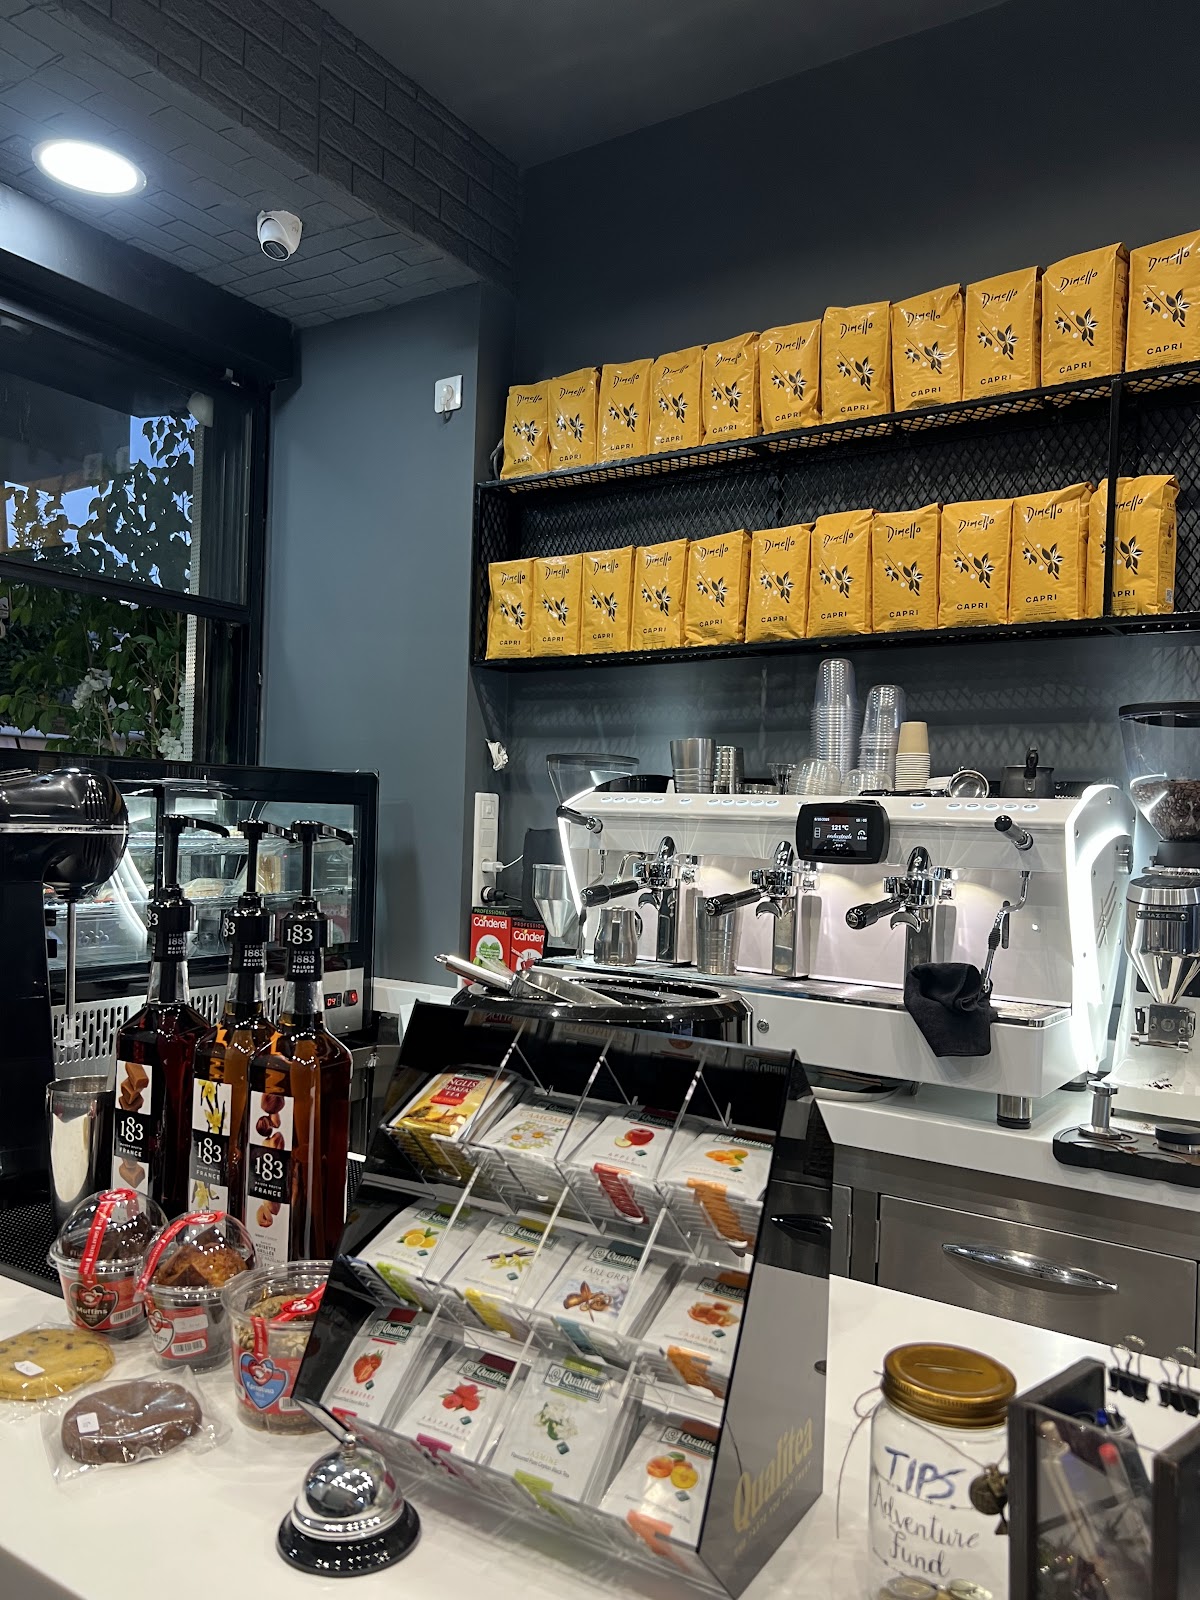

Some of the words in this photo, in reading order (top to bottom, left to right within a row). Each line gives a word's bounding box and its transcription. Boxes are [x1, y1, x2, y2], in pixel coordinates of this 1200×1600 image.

[1060, 269, 1098, 292] Dimello
[982, 289, 1018, 308] Dimello
[907, 310, 940, 327] Dimello
[840, 319, 872, 338] Dimello
[775, 336, 806, 354] Dimello
[1147, 342, 1182, 354] CAPRI
[662, 364, 690, 378] Dimello
[1059, 361, 1092, 374] CAPRI
[613, 373, 640, 388] Dimello
[980, 375, 1012, 385] CAPRI
[560, 386, 586, 399] Dimello
[911, 387, 941, 398] CAPRI
[517, 394, 542, 406] Dimello
[775, 412, 802, 422] CAPRI
[712, 424, 737, 434] CAPRI
[660, 436, 683, 444] CAPRI
[513, 456, 532, 464] CAPRI
[560, 454, 582, 462] CAPRI
[1116, 494, 1143, 512] imello
[1026, 504, 1062, 524] Dimello
[886, 522, 920, 542] Dimello
[958, 516, 994, 534] Dimello
[764, 536, 795, 554] Dimello
[824, 528, 854, 548] Dimello
[700, 543, 728, 560] Dimello
[594, 560, 619, 575] Dimello
[646, 552, 672, 569] Dimello
[501, 571, 526, 585] Dimello
[546, 565, 570, 580] Dimello
[1026, 594, 1057, 602] CAPRI
[956, 602, 988, 610] CAPRI
[821, 611, 847, 620] CAPRI
[890, 610, 918, 618] CAPRI
[700, 619, 723, 628] CAPRI
[474, 916, 508, 929] Canderel
[120, 1148, 142, 1158] FRANCE
[196, 1170, 220, 1180] FRANCE
[254, 1186, 282, 1198] FRANCE
[582, 1266, 604, 1276] EARL
[76, 1304, 108, 1316] Muffins
[383, 1322, 410, 1338] Qualitea
[563, 1372, 600, 1393] Qualitea
[682, 1433, 716, 1452] Qualite
[734, 1418, 812, 1532] Qualitea
[884, 1445, 966, 1500] TIPS
[874, 1482, 980, 1548] Adventure
